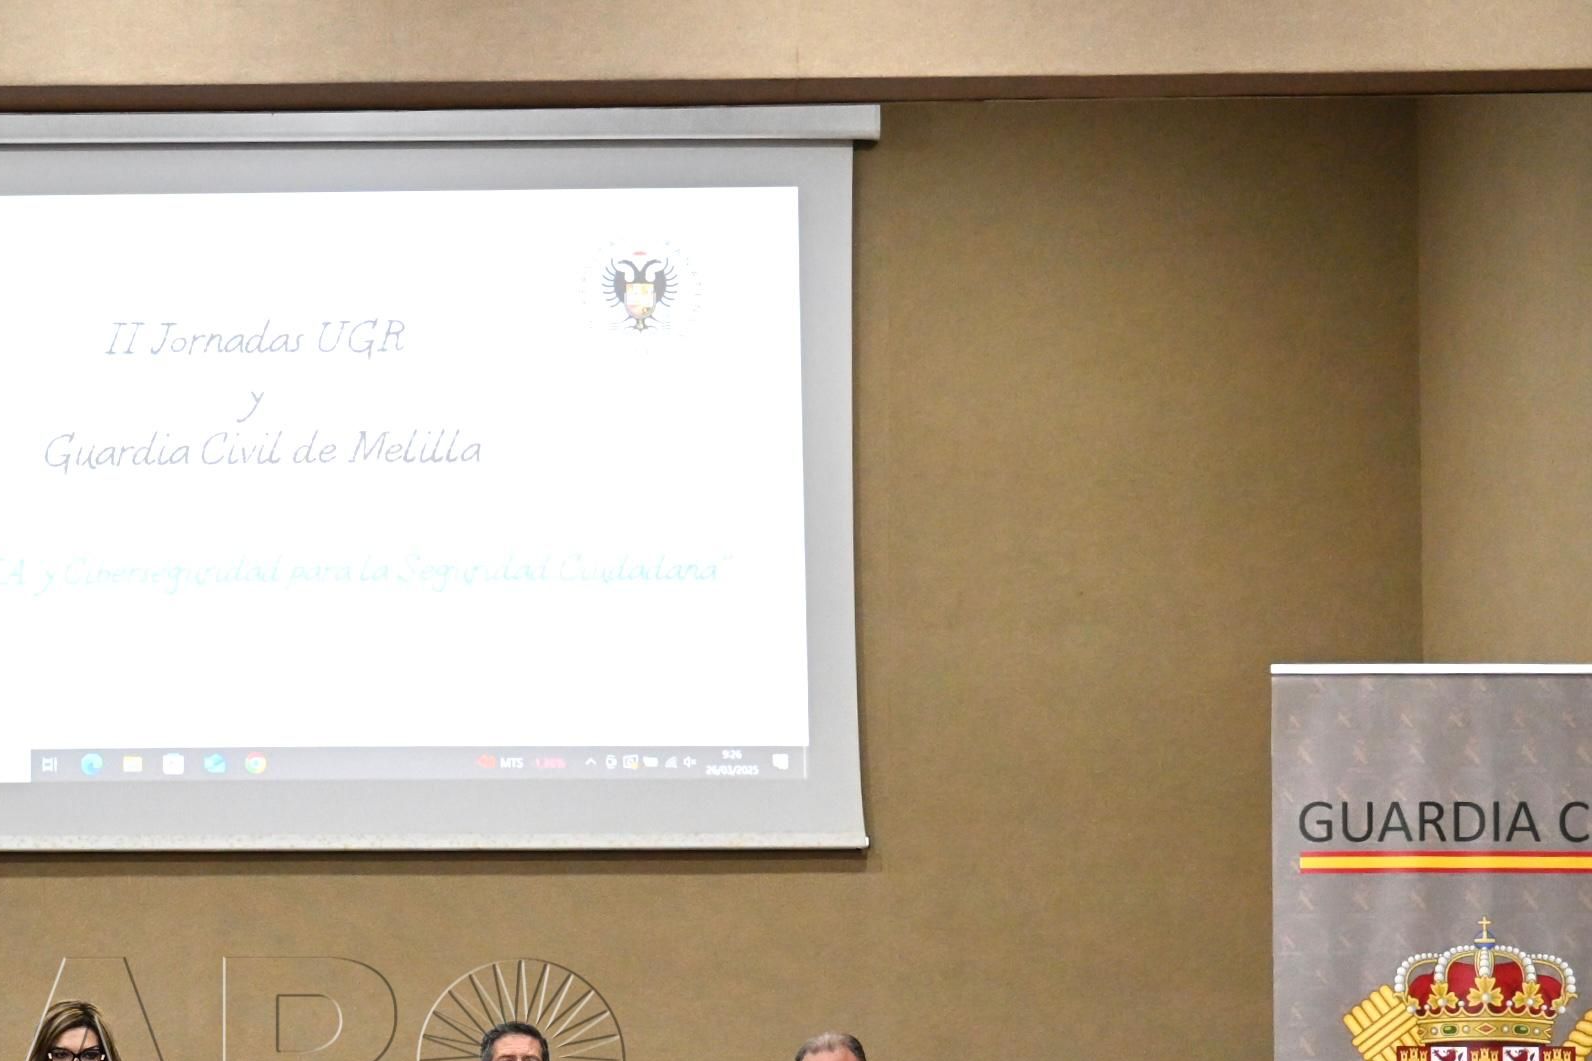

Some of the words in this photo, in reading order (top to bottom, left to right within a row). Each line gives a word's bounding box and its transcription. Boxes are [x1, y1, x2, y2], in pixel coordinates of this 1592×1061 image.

[149, 319, 304, 356] Jornadas
[316, 318, 406, 359] UGR
[236, 390, 265, 424] y
[44, 431, 190, 474] Guardia
[200, 429, 283, 466] Civil
[292, 429, 337, 465] de
[347, 428, 483, 465] Melilla
[358, 554, 390, 583] la
[1298, 800, 1542, 843] GUARDIA
